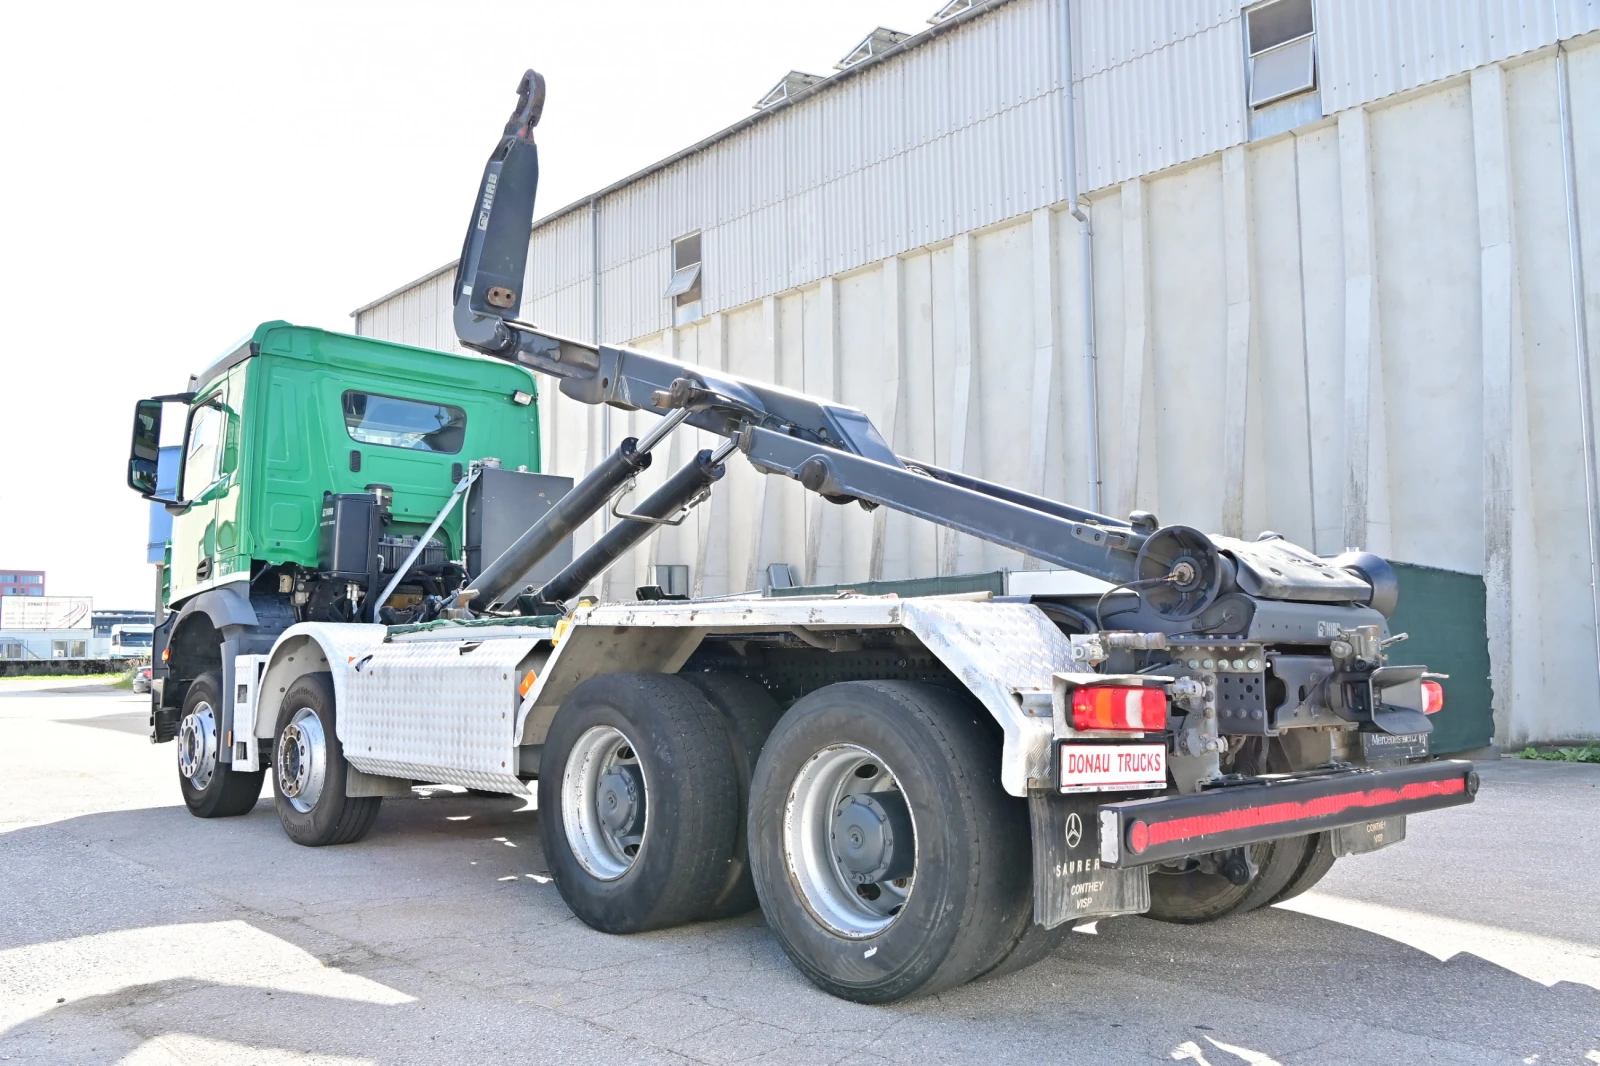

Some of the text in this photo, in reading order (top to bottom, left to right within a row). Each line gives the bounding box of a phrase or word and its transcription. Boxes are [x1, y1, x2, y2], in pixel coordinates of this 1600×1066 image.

[482, 172, 498, 210] HIAB
[1068, 753, 1161, 774] DONAU TRUCKS
[1055, 858, 1100, 878] SAURER
[1070, 881, 1105, 896] CONTHEY
[1076, 897, 1093, 910] VISP
